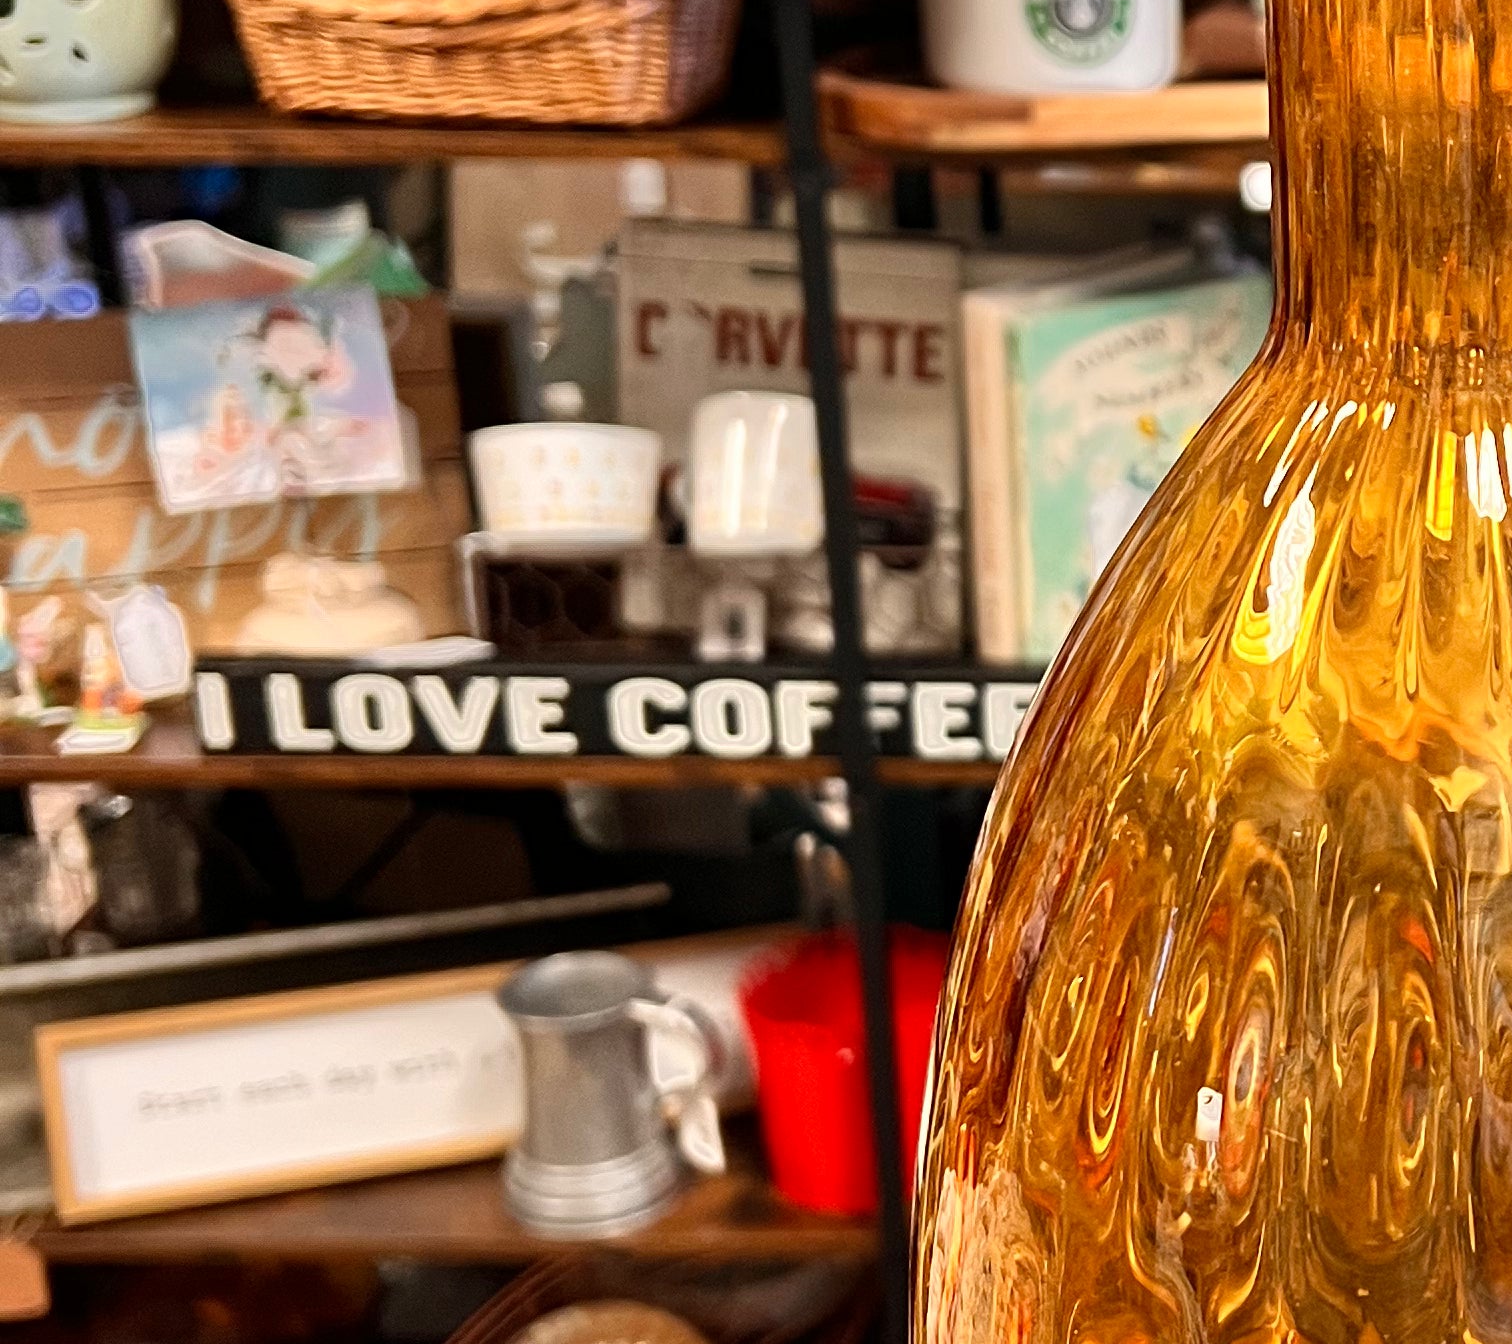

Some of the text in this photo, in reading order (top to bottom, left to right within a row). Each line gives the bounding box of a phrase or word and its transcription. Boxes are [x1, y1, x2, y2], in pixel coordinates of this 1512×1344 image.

[633, 300, 946, 383] CRVTTE
[195, 671, 235, 751] I
[264, 672, 579, 754] LOVE
